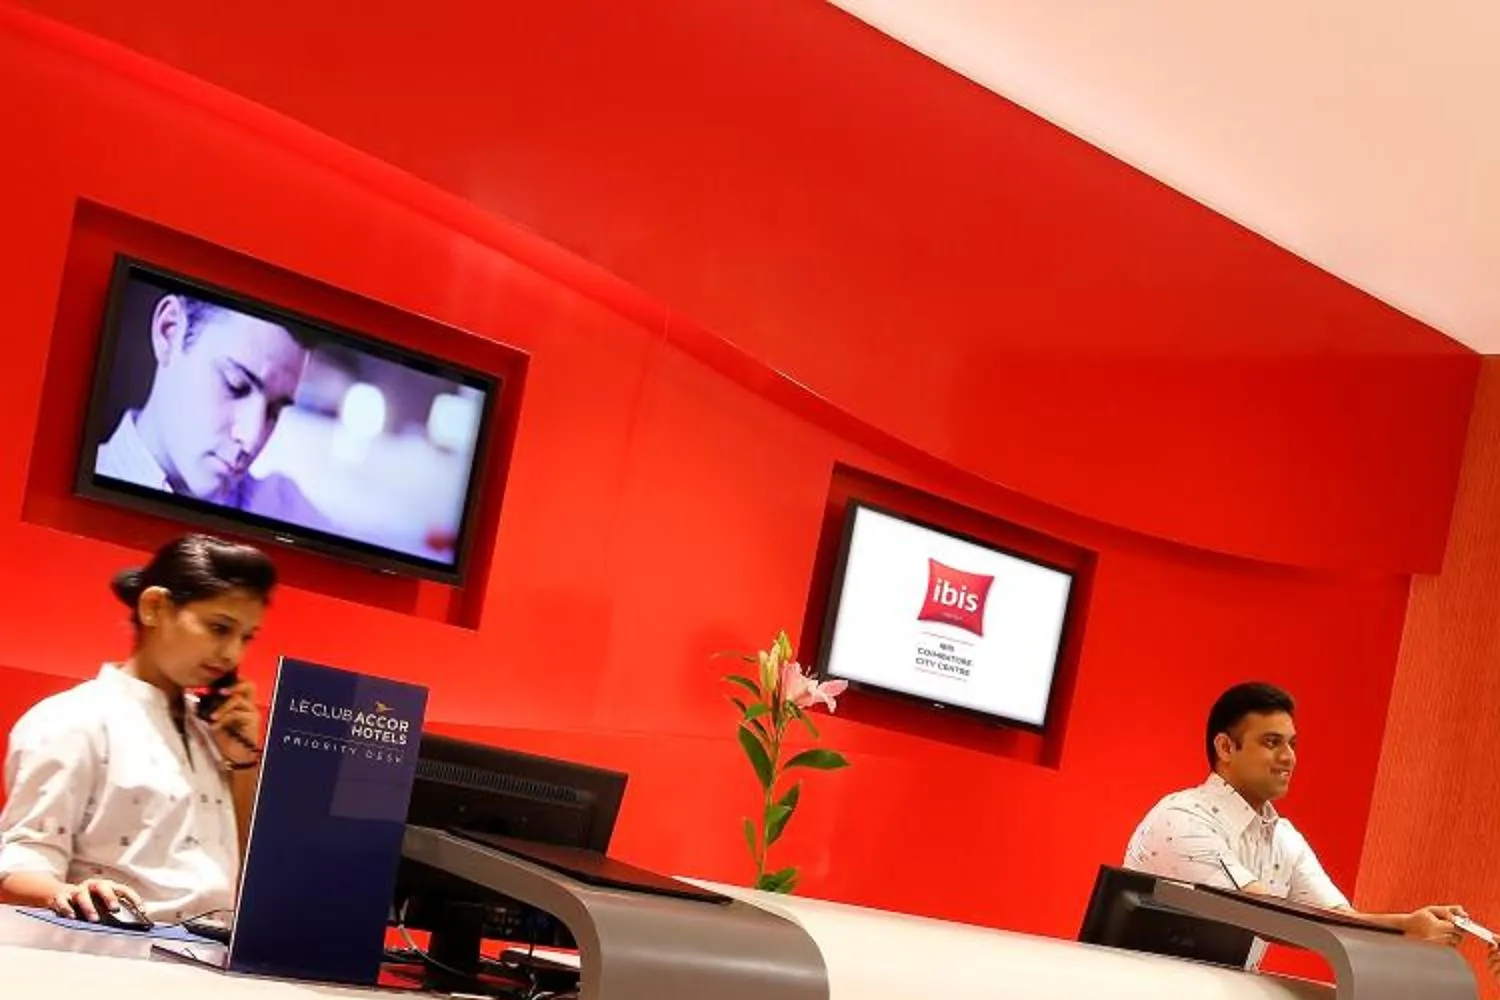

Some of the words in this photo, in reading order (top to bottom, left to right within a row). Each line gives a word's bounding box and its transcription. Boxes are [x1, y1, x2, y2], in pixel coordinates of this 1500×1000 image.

[932, 577, 979, 613] ibis
[915, 657, 937, 668] CITY
[289, 698, 310, 713] LE
[310, 703, 353, 721] CLUB
[353, 711, 409, 733] ACCOR
[351, 725, 408, 745] HOTELS
